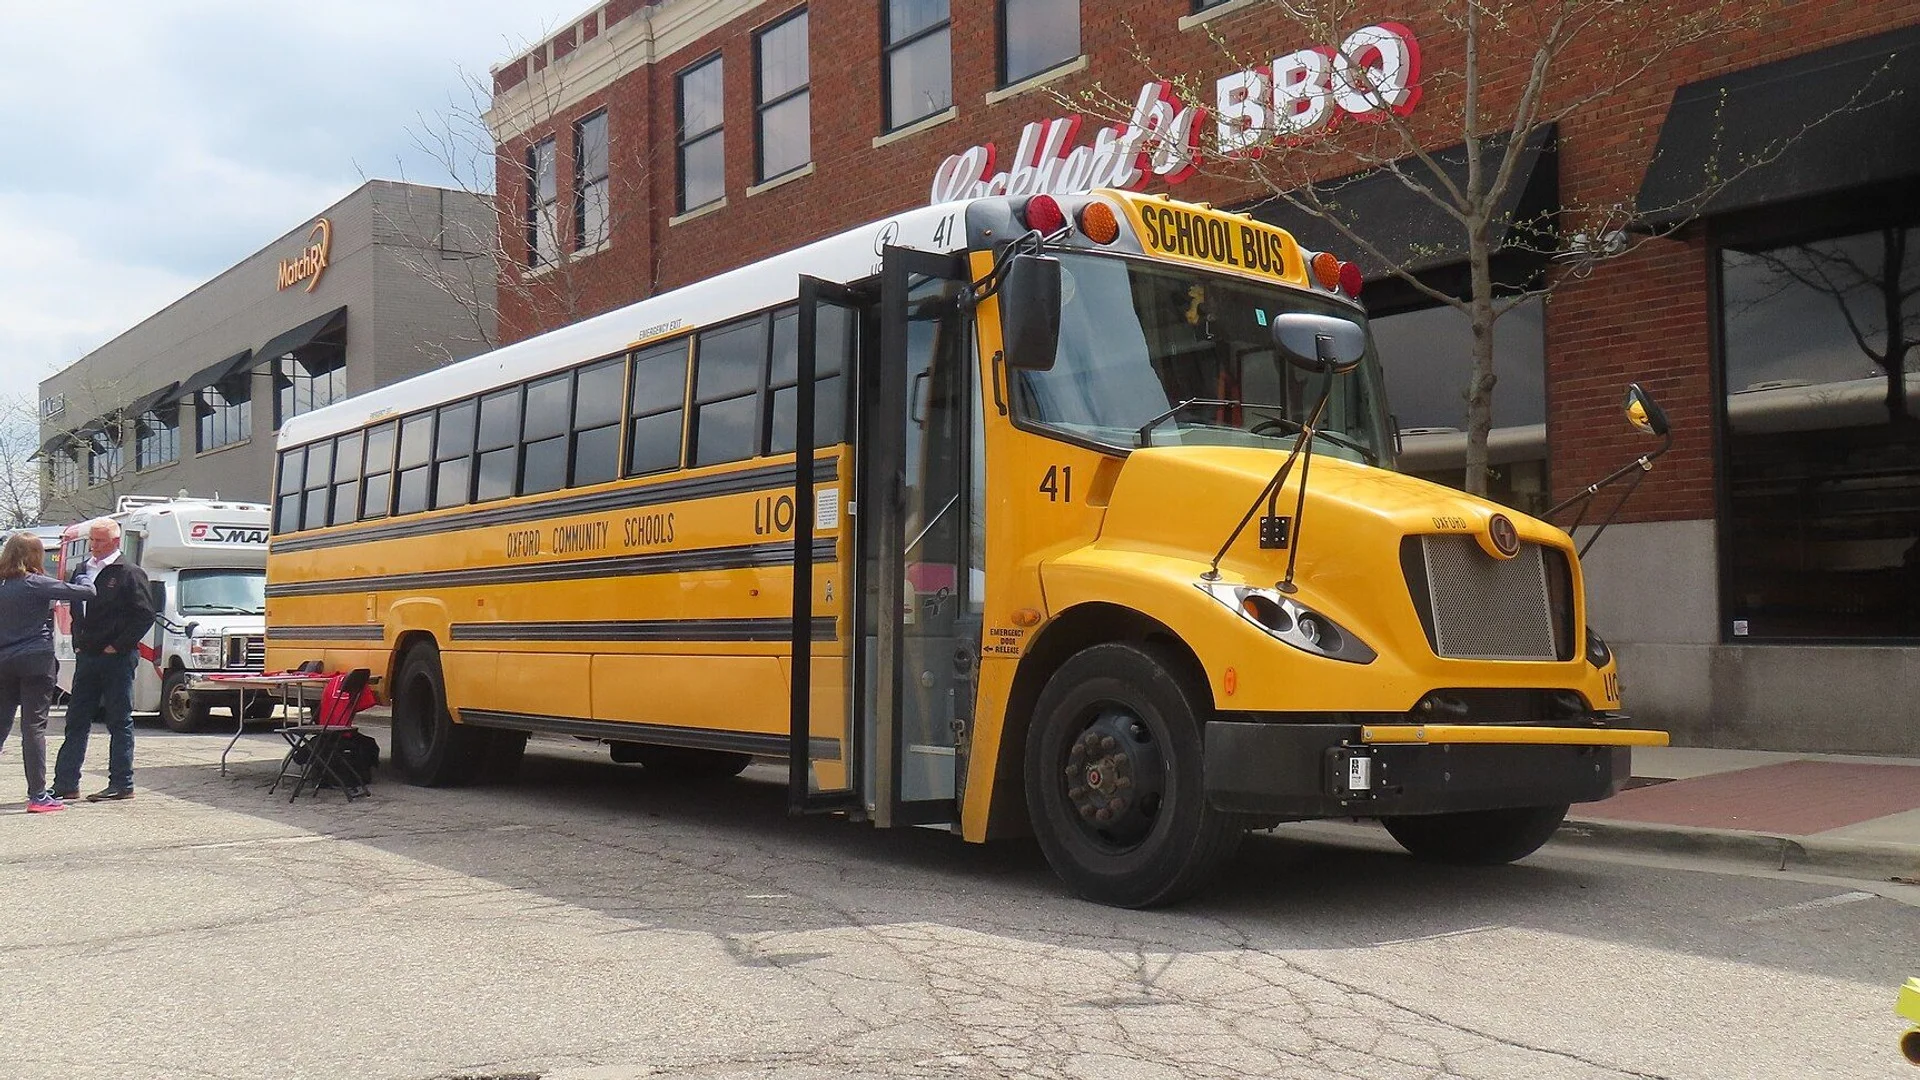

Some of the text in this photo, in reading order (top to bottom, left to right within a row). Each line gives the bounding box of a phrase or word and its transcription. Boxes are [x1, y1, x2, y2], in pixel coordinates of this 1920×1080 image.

[1216, 22, 1422, 155] BBQ
[933, 213, 955, 249] 41
[1142, 204, 1285, 276] SCHOOL BUS
[1039, 465, 1071, 502] 41
[507, 512, 675, 558] OXFORD COMMUNITY SCHOOLS
[1431, 517, 1467, 530] OXFORD
[990, 628, 1024, 637] EMERGENCY
[994, 646, 1019, 654] RELEASE
[1000, 637, 1016, 645] DOOR
